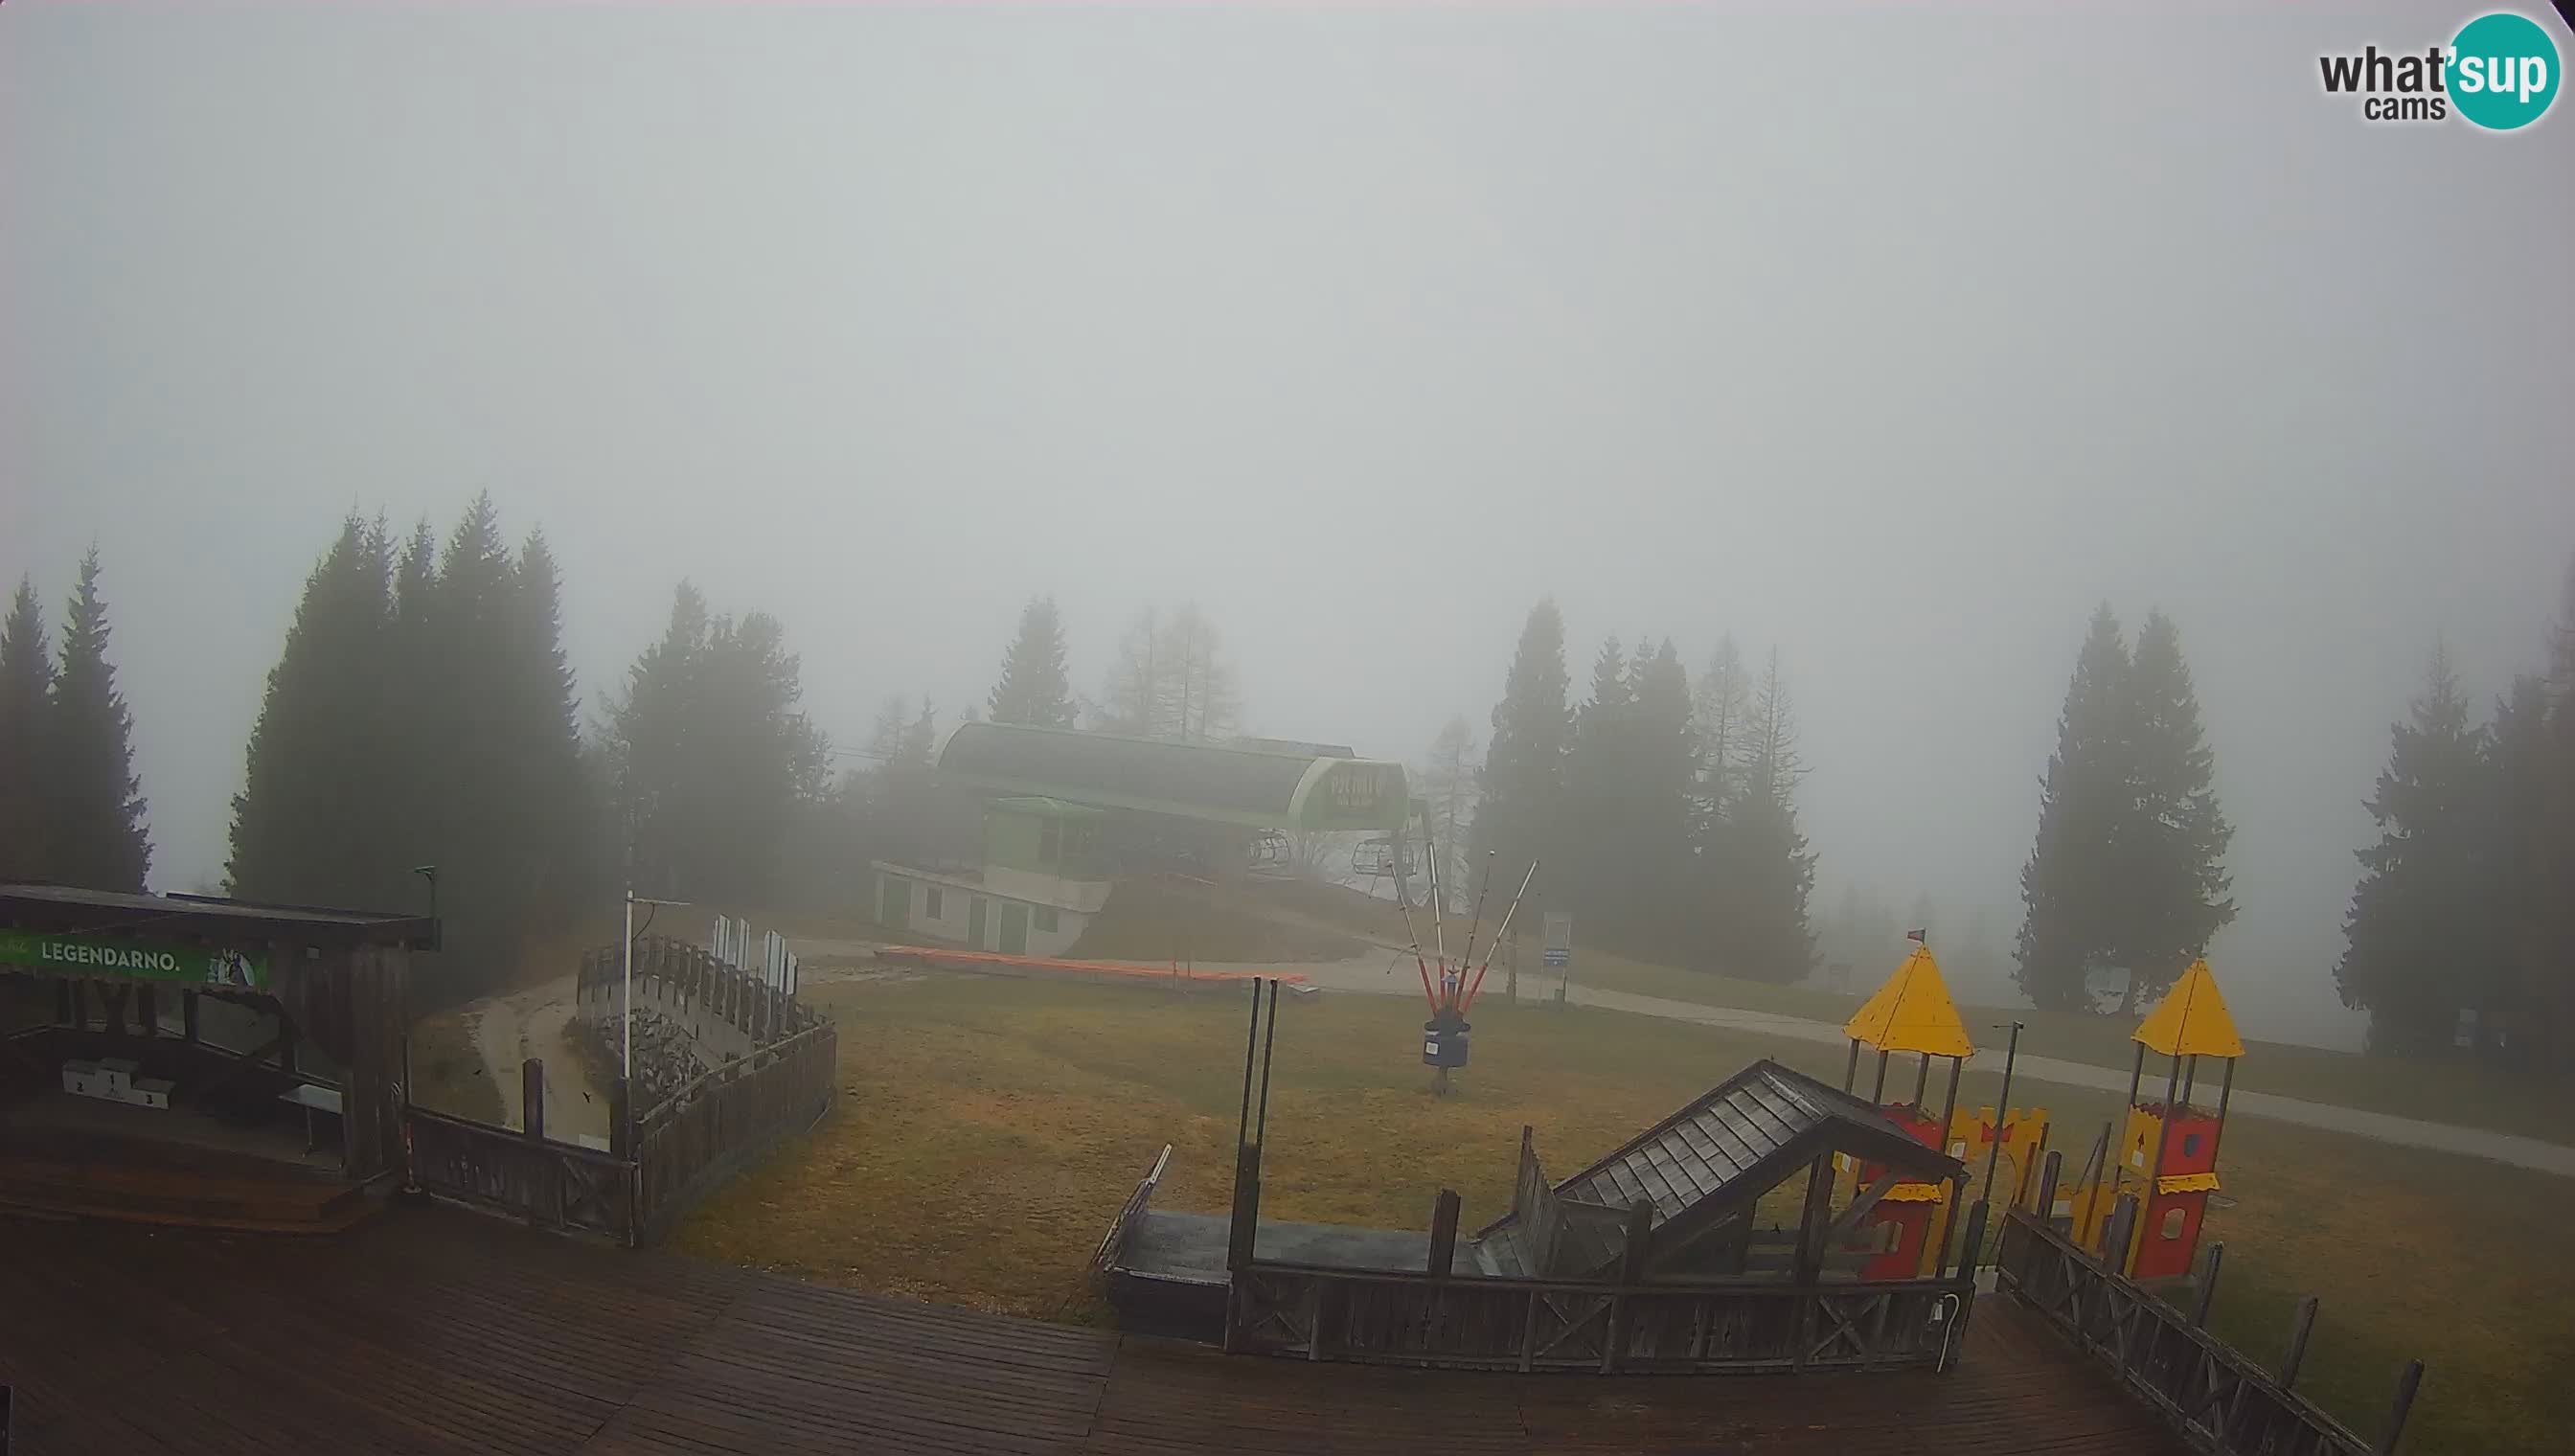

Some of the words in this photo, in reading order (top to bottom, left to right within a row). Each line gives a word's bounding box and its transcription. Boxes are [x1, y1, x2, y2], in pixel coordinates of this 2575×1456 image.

[41, 942, 181, 972] LEGENDARNO.
[77, 1081, 84, 1093] 2
[146, 1093, 153, 1104] 3
